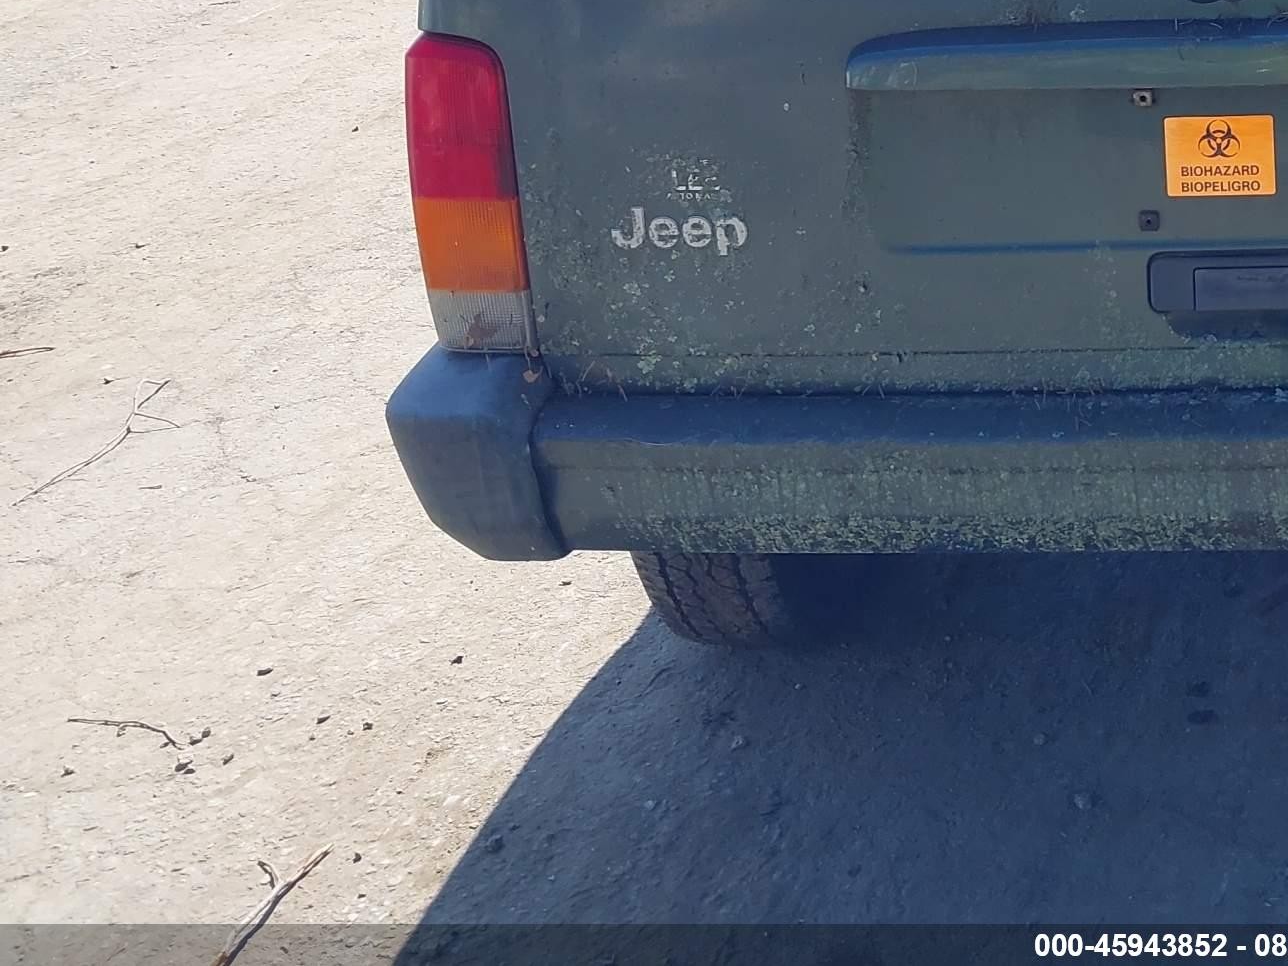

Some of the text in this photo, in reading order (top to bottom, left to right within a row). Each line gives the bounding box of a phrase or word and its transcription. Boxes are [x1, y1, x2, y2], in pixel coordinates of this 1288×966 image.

[1181, 165, 1260, 177] BIOHAZARD
[1181, 180, 1261, 193] BIOPELIGRO
[611, 206, 748, 256] Jeep
